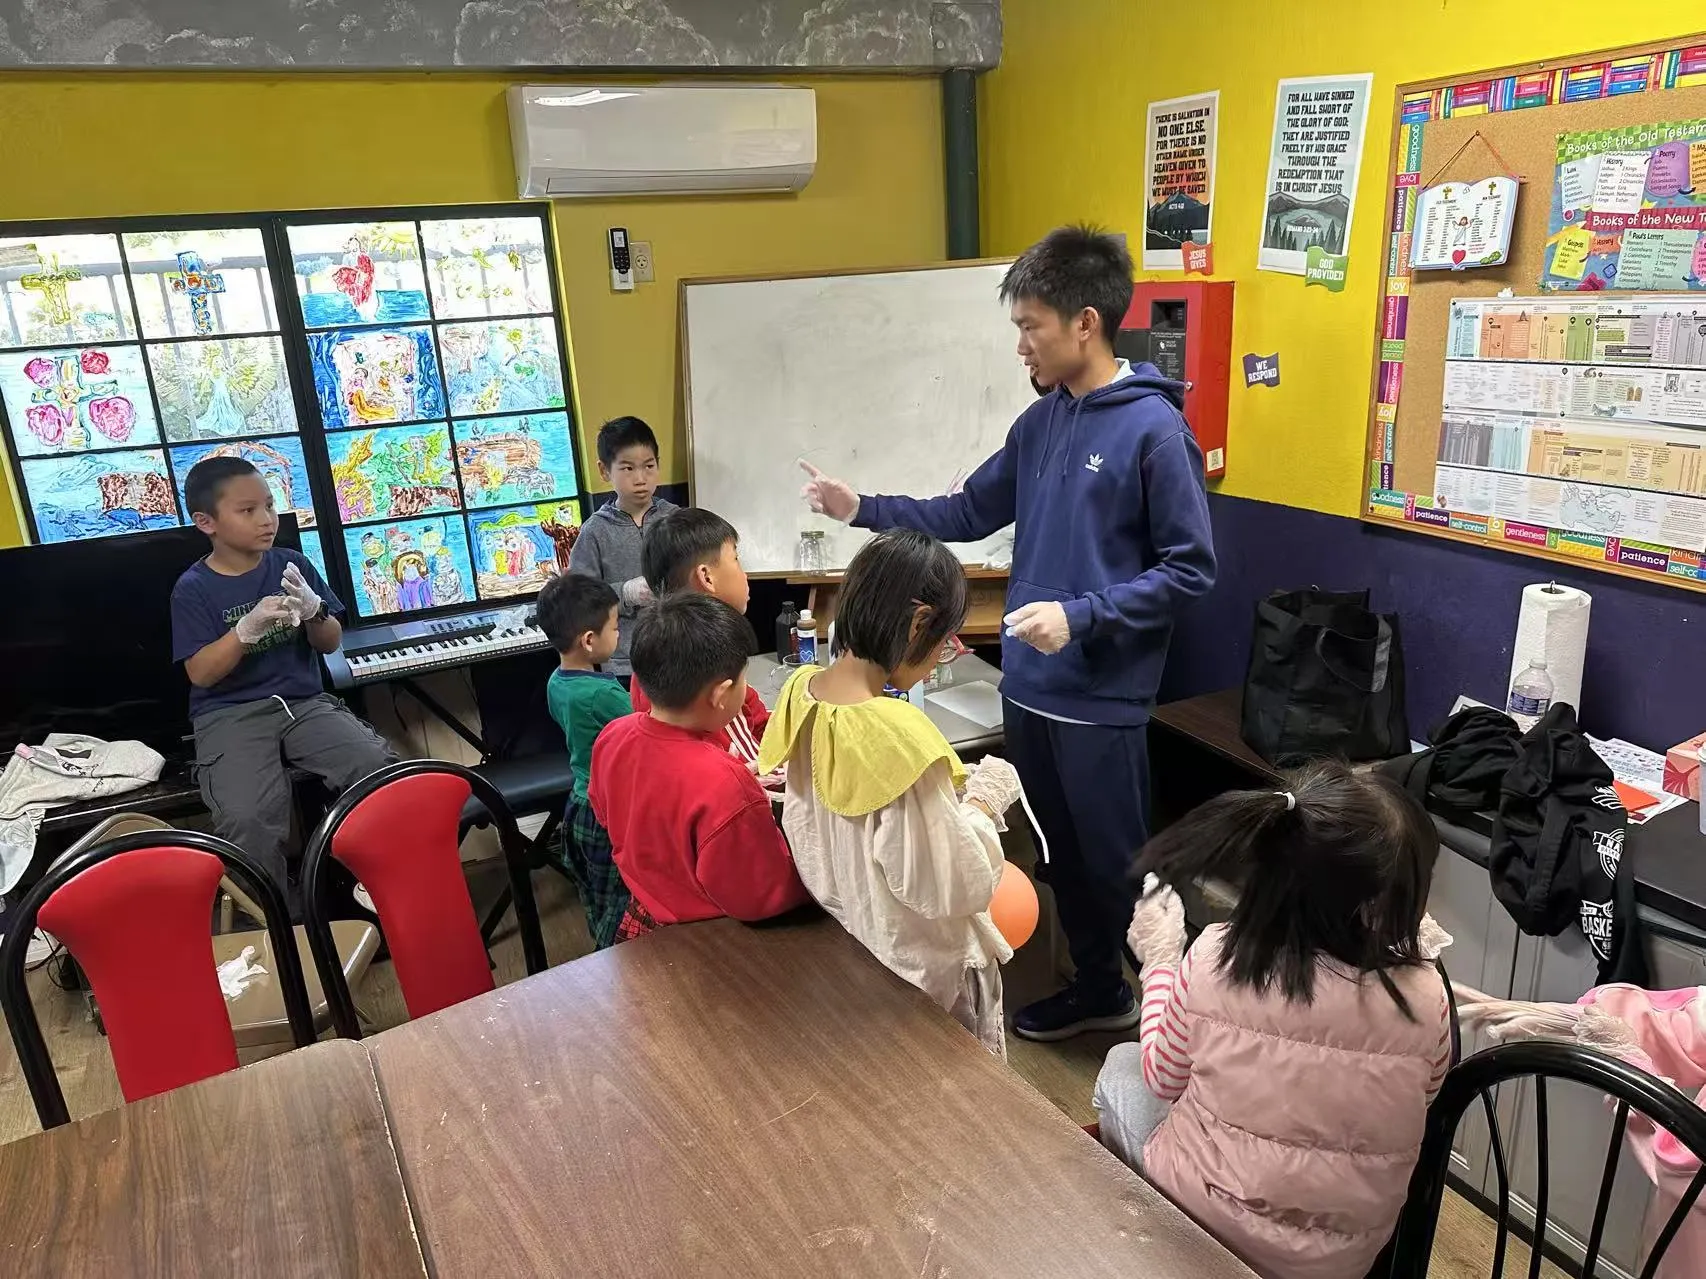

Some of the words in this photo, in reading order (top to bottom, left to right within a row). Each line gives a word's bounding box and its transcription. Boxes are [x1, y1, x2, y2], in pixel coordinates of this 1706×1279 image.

[1288, 93, 1299, 103] FOR
[1300, 92, 1312, 102] ALL
[1313, 91, 1330, 102] HAVE
[1331, 90, 1355, 101] SINNED
[1155, 113, 1171, 124] THERE
[1172, 112, 1178, 121] IS
[1178, 107, 1203, 120] SALVATION
[1204, 107, 1210, 116] IN
[1286, 105, 1300, 115] AND
[1301, 104, 1317, 115] FALL
[1318, 103, 1342, 114] SHORT
[1342, 103, 1353, 113] OF
[1287, 118, 1300, 128] THE
[1300, 117, 1323, 128] GLORY
[1323, 117, 1333, 127] OF
[1158, 125, 1168, 138] NO
[1169, 122, 1185, 136] ONE
[1283, 131, 1300, 141] THEY
[1300, 131, 1314, 141] ARE
[1315, 130, 1350, 141] JUSTIFIED
[1156, 139, 1168, 150] FOR
[1169, 136, 1189, 149] THERE
[1190, 135, 1197, 146] IS
[1198, 134, 1206, 145] NO
[1410, 124, 1420, 172] goodness
[1566, 140, 1597, 154] Books
[1601, 136, 1614, 152] of
[1615, 134, 1634, 147] the
[1638, 129, 1658, 142] Old
[1156, 151, 1172, 161] OTHER
[1173, 149, 1188, 159] NAME
[1188, 148, 1204, 157] UNDER
[1281, 144, 1305, 153] FREELY
[1305, 144, 1314, 153] BY
[1315, 144, 1326, 153] HIS
[1326, 144, 1347, 153] GRACE
[1154, 161, 1177, 173] HEAVEN
[1178, 159, 1196, 171] GIVEN
[1197, 158, 1206, 169] TO
[1287, 155, 1321, 166] THROUGH
[1322, 155, 1338, 166] THE
[1153, 174, 1175, 185] PEOPLE
[1175, 173, 1185, 183] BY
[1185, 171, 1206, 182] WHICH
[1278, 169, 1323, 180] REDEMPTION
[1324, 169, 1345, 180] THAT
[1399, 174, 1417, 184] love
[1152, 187, 1161, 197] WE
[1162, 186, 1177, 196] MUST
[1178, 185, 1186, 194] BE
[1275, 182, 1283, 192] IS
[1283, 182, 1291, 192] IN
[1291, 182, 1318, 193] CHRIST
[1318, 183, 1343, 194] JESUS
[1396, 189, 1404, 231] patience
[1593, 215, 1623, 227] Books
[1627, 213, 1640, 225] of
[1641, 214, 1661, 225] the
[1664, 213, 1695, 224] New
[1596, 238, 1614, 246] History
[1189, 249, 1207, 261] JESUS
[1190, 258, 1207, 270] GIVES
[1319, 258, 1334, 269] GOD
[1307, 268, 1344, 281] PROVIDED
[1390, 280, 1406, 293] joy
[1387, 297, 1395, 338] gentleness
[1255, 360, 1268, 371] WE
[1248, 367, 1277, 383] RESPOND
[1389, 362, 1399, 404] gentleness
[1379, 407, 1393, 418] joy
[1376, 422, 1384, 461] kindness
[1385, 423, 1393, 462] self-control
[1371, 492, 1405, 504] goodness
[1405, 496, 1414, 516] love
[1415, 509, 1448, 523] patience
[1451, 519, 1488, 534] self-control
[1505, 527, 1546, 541] gentleness
[1621, 551, 1666, 566] patience
[1581, 916, 1613, 937] BASKE
